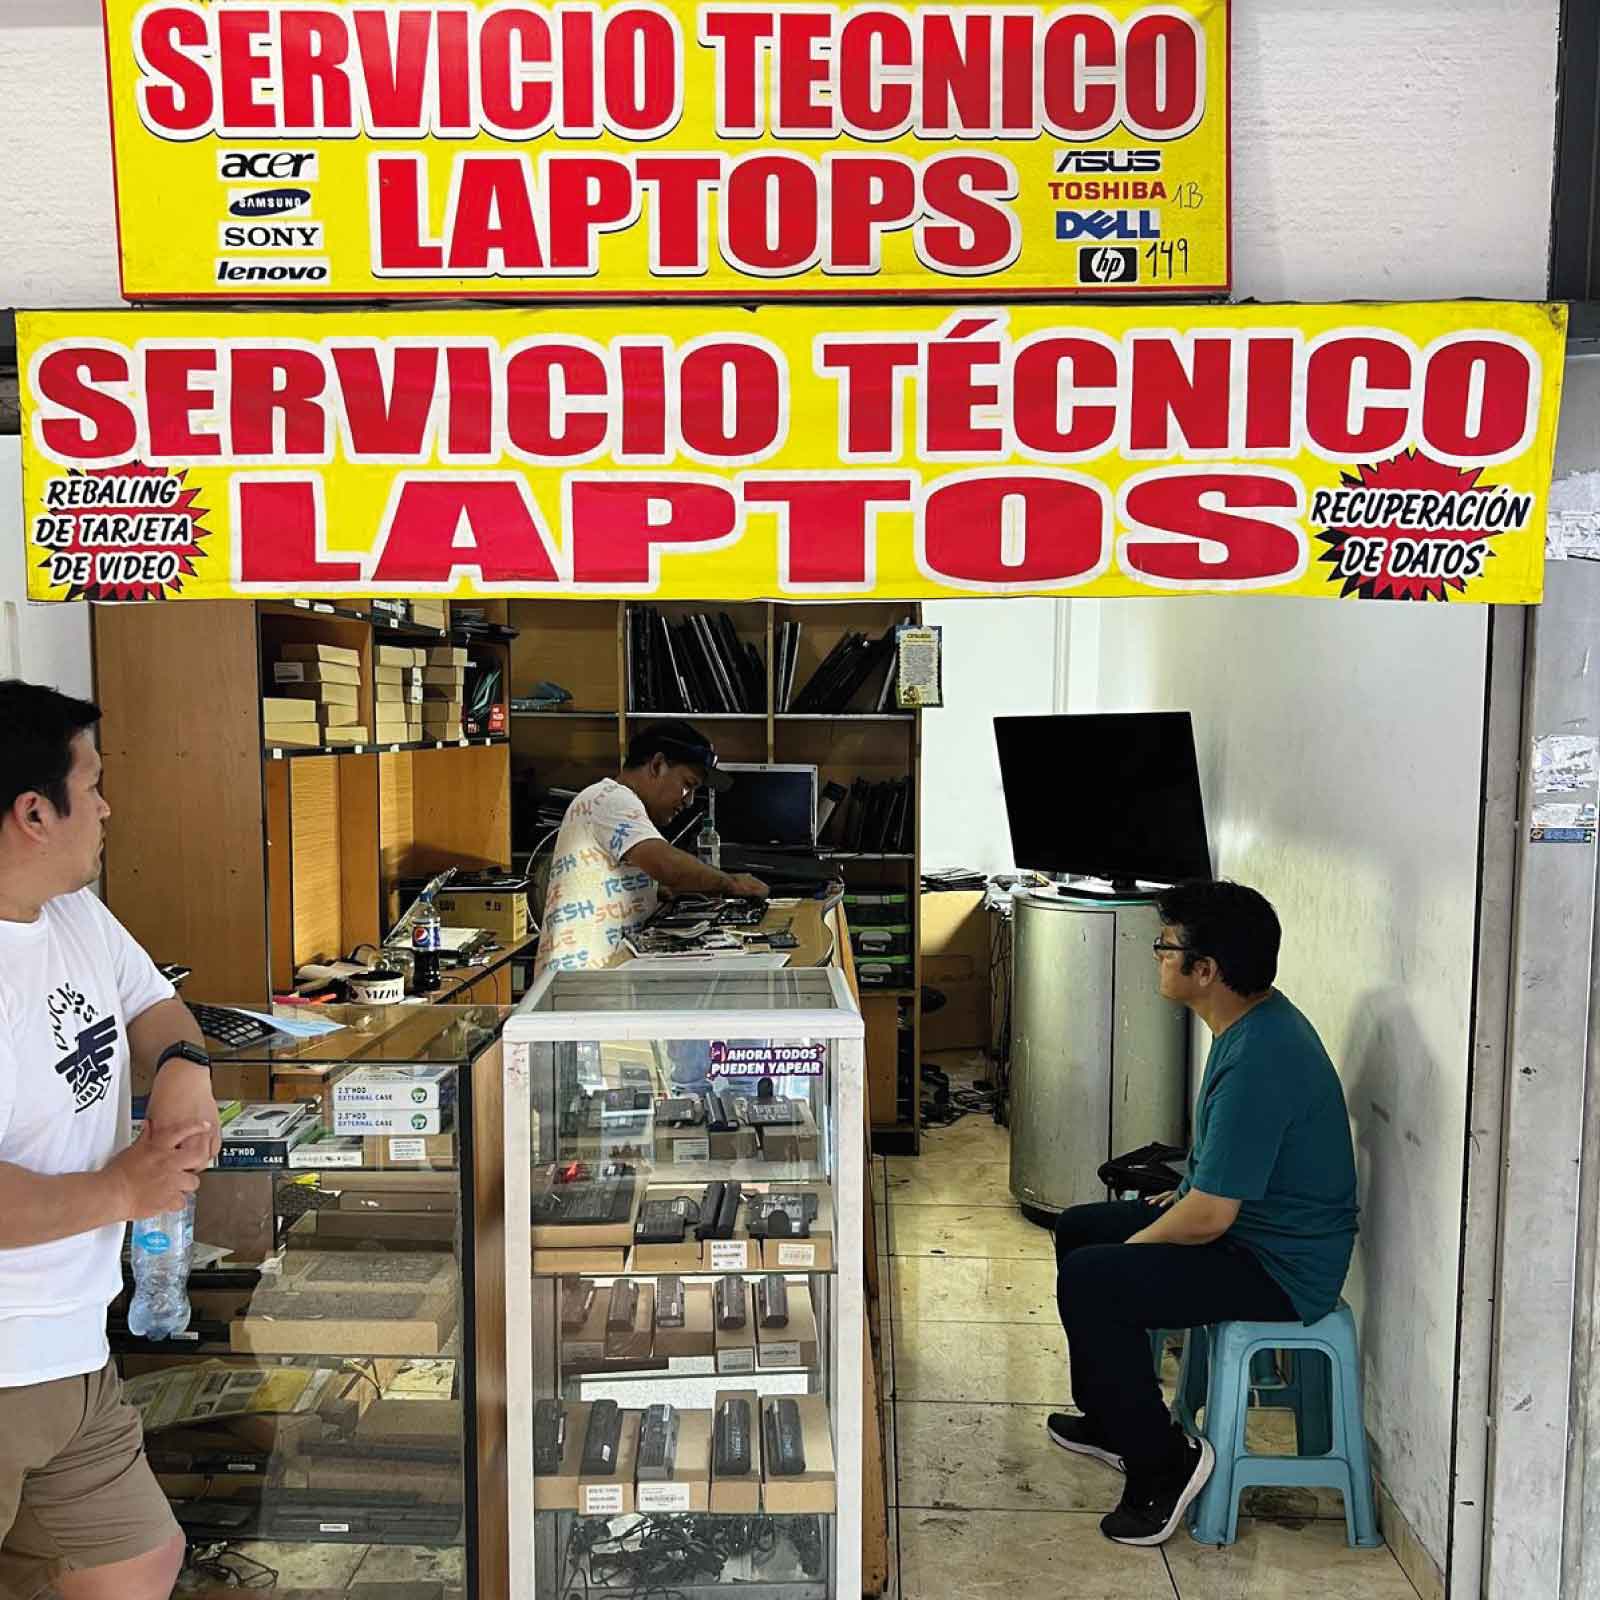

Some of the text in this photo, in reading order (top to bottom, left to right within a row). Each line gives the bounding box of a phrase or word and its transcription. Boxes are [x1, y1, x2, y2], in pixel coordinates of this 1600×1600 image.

[141, 8, 1196, 132] SERVICIO TECNICO
[220, 151, 315, 178] acer
[1055, 149, 1161, 172] ASUS
[238, 196, 302, 209] SAMSUNG
[1047, 181, 1168, 201] TOSHIBA
[378, 156, 1012, 269] LAPTOPS
[1055, 209, 1161, 240] DELL
[224, 226, 320, 247] SONY
[217, 260, 328, 281] lenovo
[1144, 237, 1190, 281] 149
[38, 318, 1530, 459] SERVICIO TÉCNICO
[47, 478, 178, 506] REBALING
[1311, 487, 1532, 529] RECUPERACIÓN
[35, 516, 190, 544] DE TARJETA
[239, 474, 1299, 583] LAPTOS
[52, 554, 176, 582] DE VIDEO
[1344, 540, 1485, 575] DE DATOS
[710, 1060, 821, 1075] PUEDEN YAPEAR
[727, 1047, 818, 1061] AHORA TODOS
[375, 1093, 393, 1101] CASE
[375, 1119, 393, 1127] CASE
[262, 1155, 285, 1164] CASE
